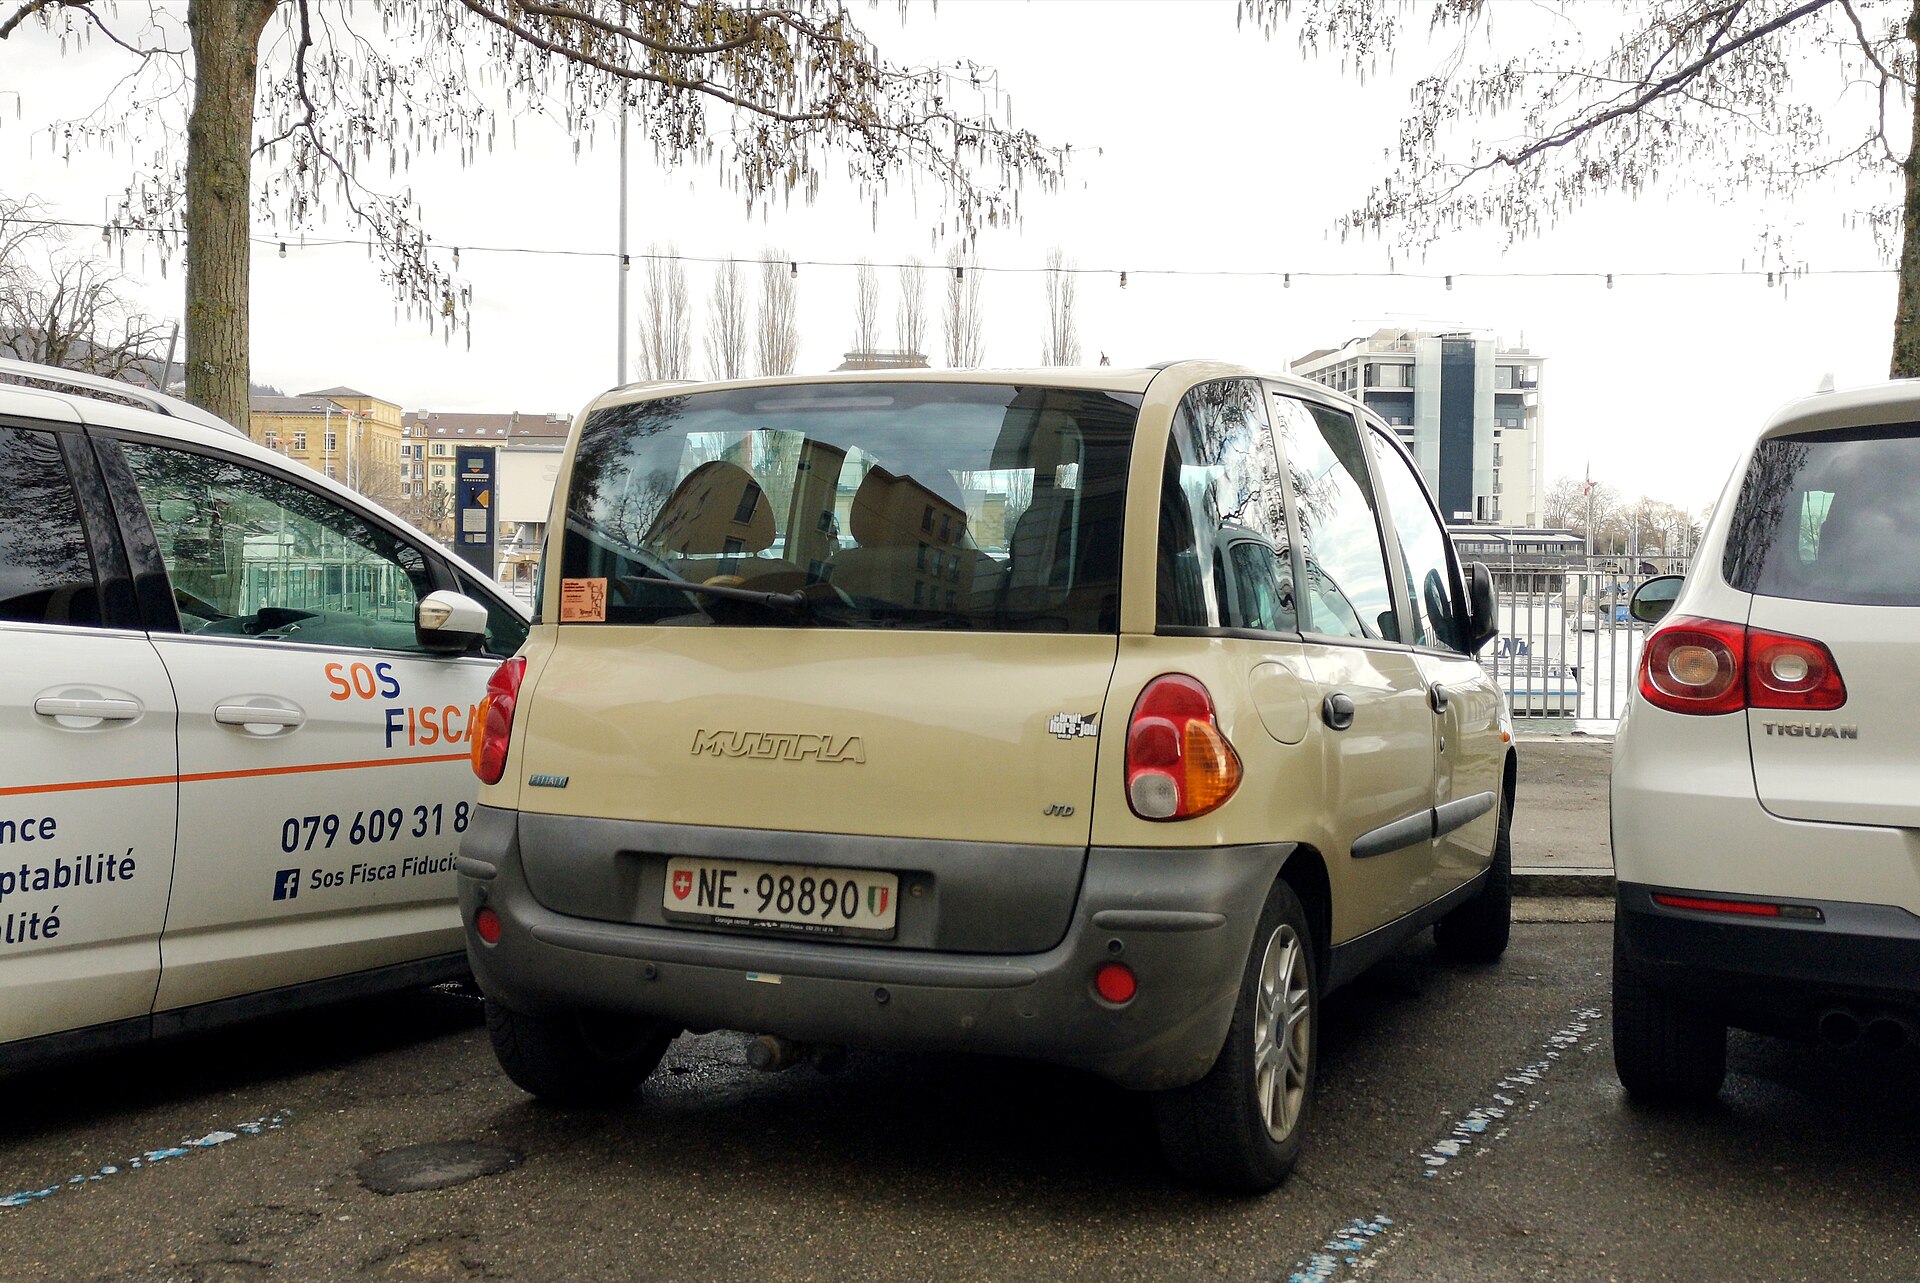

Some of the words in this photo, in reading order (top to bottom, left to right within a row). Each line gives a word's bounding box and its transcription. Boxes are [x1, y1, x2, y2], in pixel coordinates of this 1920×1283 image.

[325, 662, 401, 701] SOS
[691, 729, 866, 763] MULTIPLA
[1763, 721, 1857, 739] TIGUAN
[282, 814, 340, 853] 079
[350, 807, 403, 845] 609
[412, 803, 442, 837] 31
[453, 801, 476, 833] 8
[1043, 804, 1074, 816] JTD
[0, 847, 136, 903] ptabilité
[310, 869, 344, 889] Sos
[350, 863, 396, 884] Fisca
[697, 868, 737, 909] NE
[757, 873, 859, 919] 98890
[0, 905, 60, 944] lité
